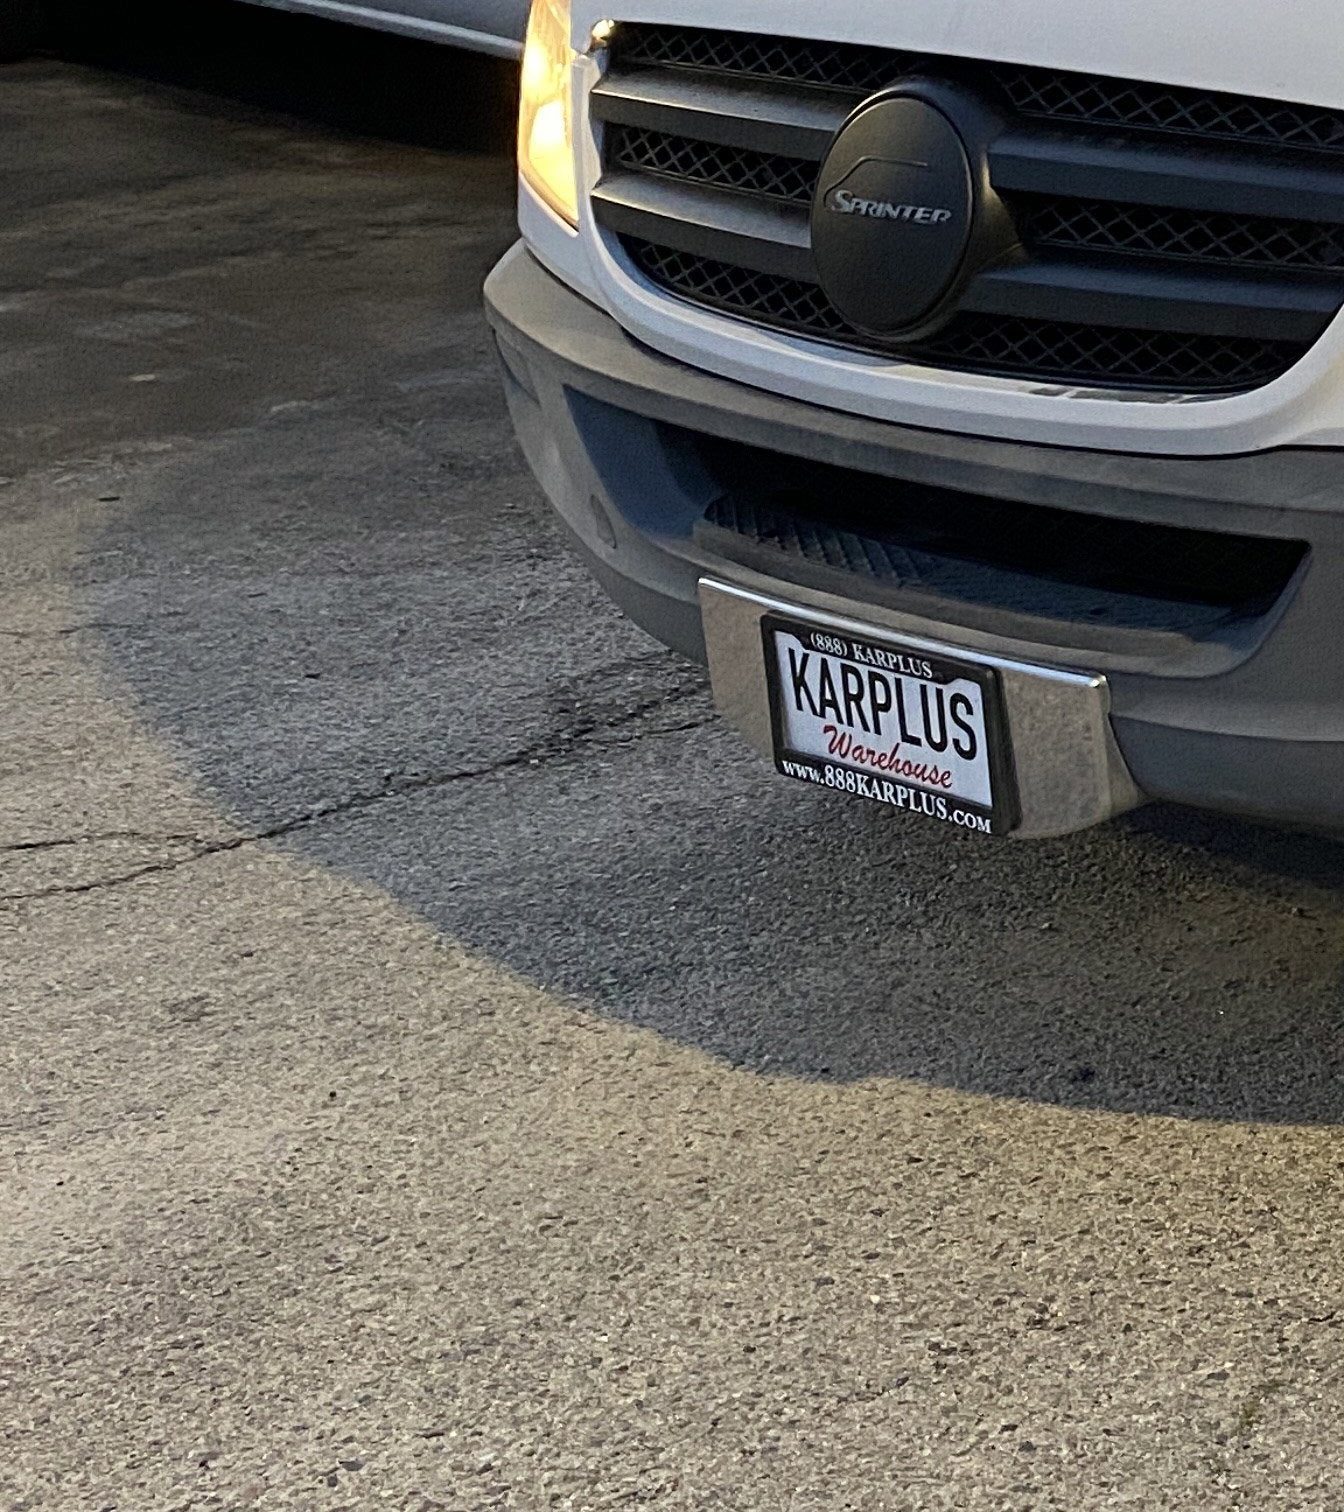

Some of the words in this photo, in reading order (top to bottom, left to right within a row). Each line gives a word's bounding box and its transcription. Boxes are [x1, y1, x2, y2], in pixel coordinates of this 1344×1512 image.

[810, 632, 848, 657] (888)
[852, 643, 933, 679] KARPLUS
[788, 648, 978, 761] KARPLUS
[823, 725, 953, 788] Warehouse
